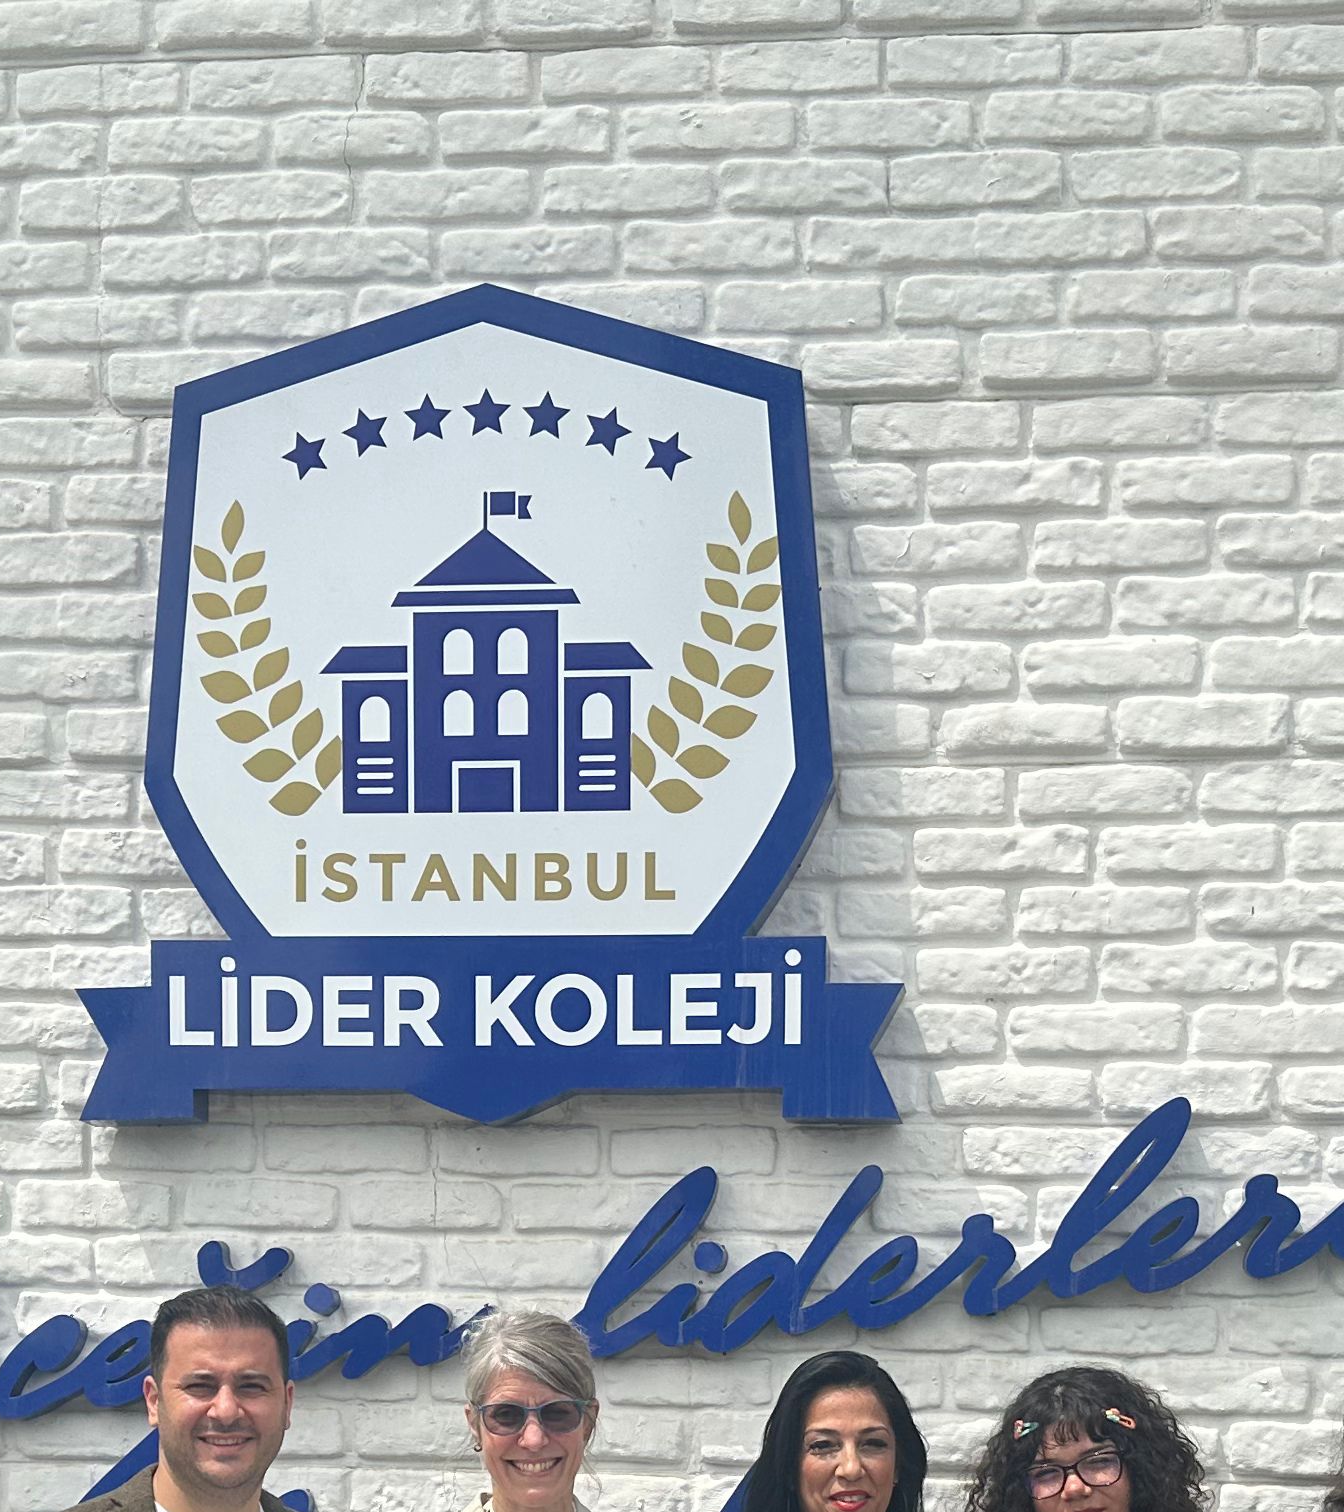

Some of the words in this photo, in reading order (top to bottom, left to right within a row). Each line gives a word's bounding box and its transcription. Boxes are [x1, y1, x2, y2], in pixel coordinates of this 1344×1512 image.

[294, 838, 677, 903] İSTANBUL
[168, 955, 442, 1049] LİDER
[475, 947, 803, 1049] KOLEJİ
